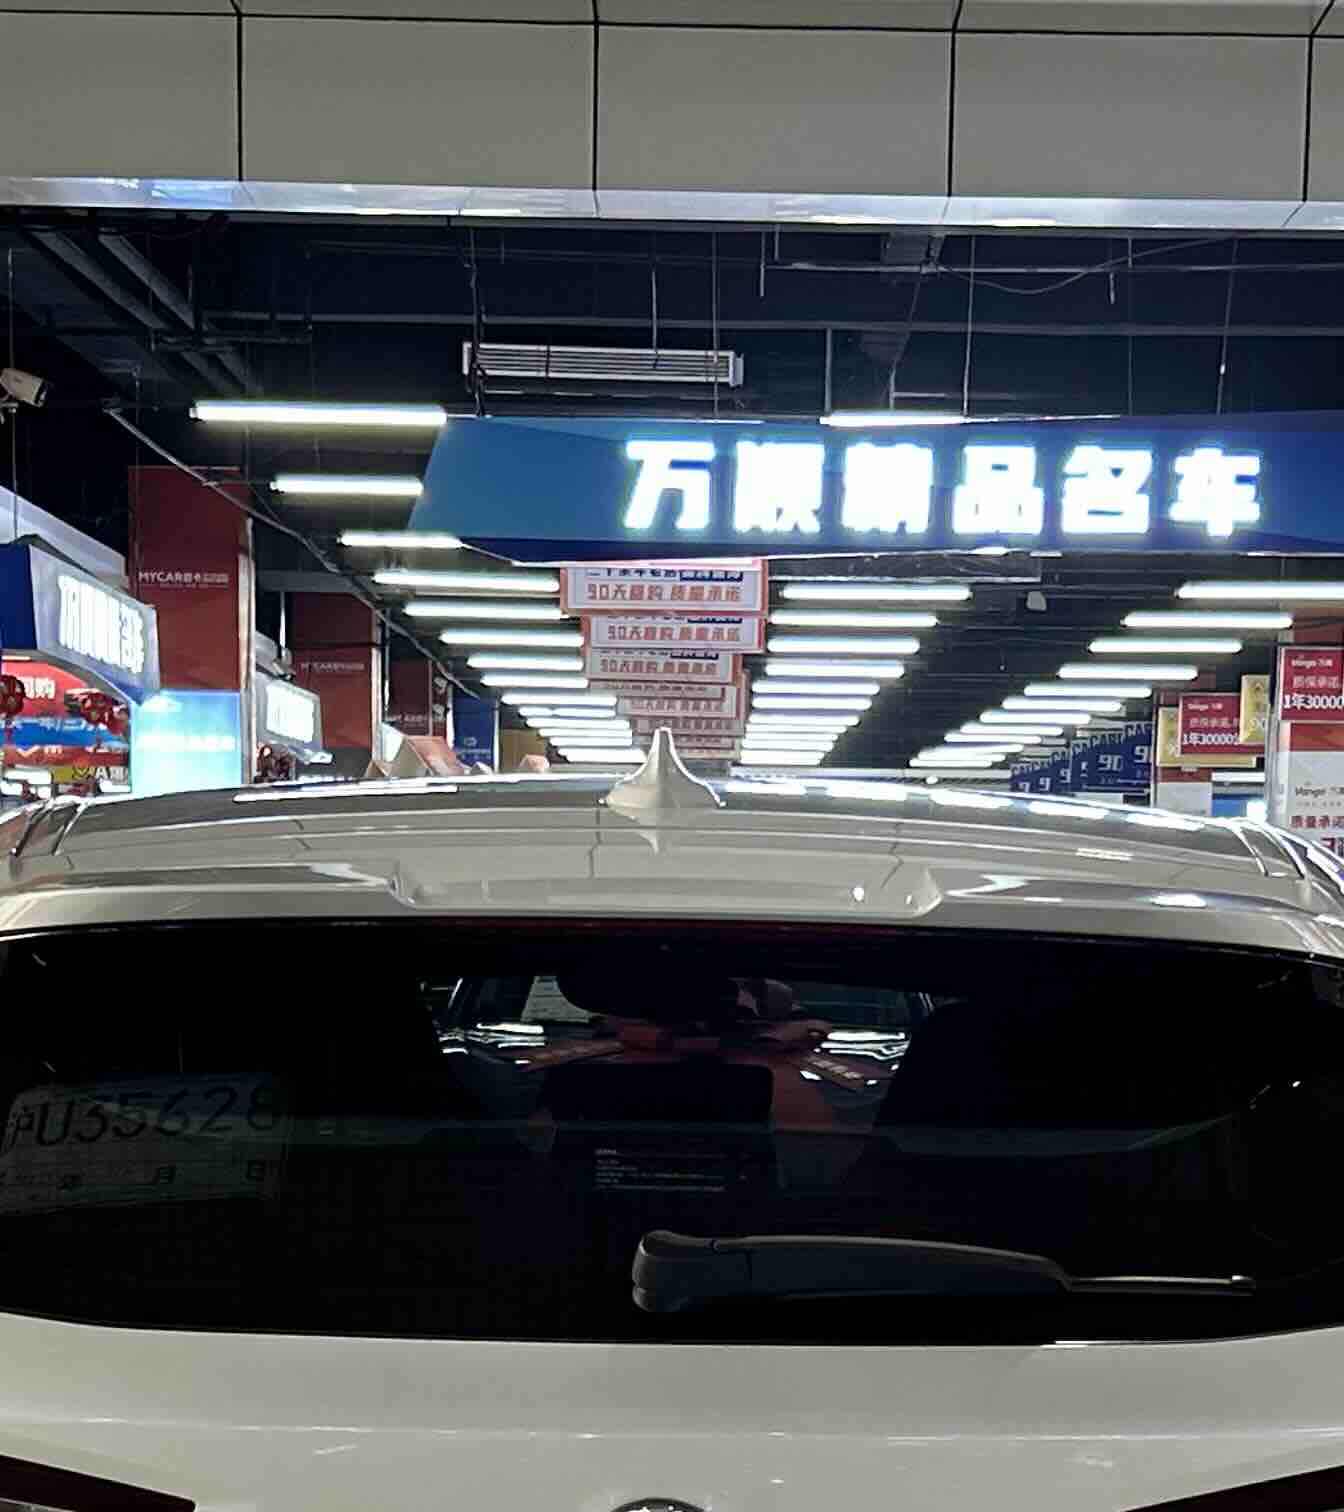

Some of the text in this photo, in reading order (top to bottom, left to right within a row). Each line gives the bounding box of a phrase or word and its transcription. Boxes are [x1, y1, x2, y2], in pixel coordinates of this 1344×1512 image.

[622, 437, 1264, 537] 万顺精品名车
